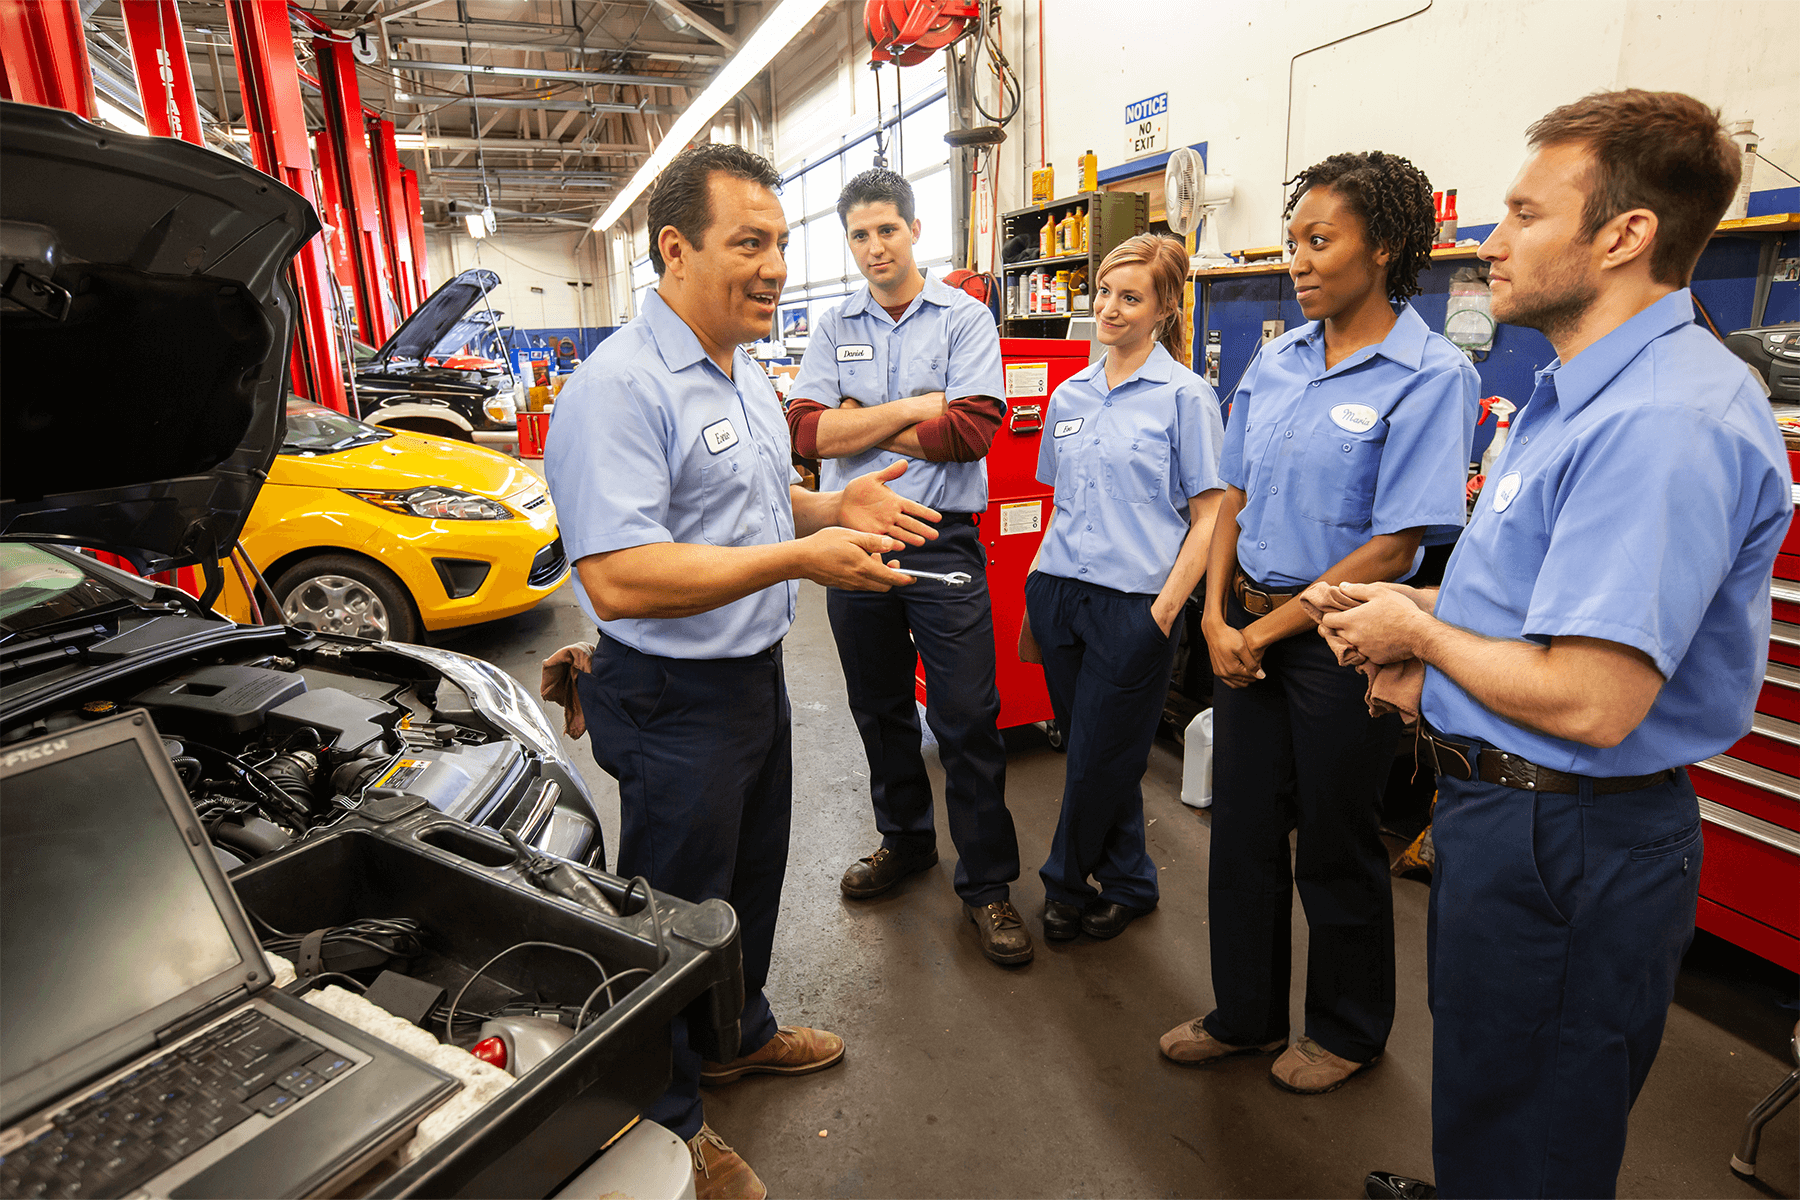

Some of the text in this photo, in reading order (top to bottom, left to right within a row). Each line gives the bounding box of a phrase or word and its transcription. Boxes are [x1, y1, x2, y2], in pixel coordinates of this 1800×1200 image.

[1126, 94, 1167, 123] NOTICE
[1139, 121, 1151, 136] NO
[1135, 135, 1155, 152] EXIT
[844, 350, 865, 358] Daniel
[1342, 409, 1370, 426] Maria
